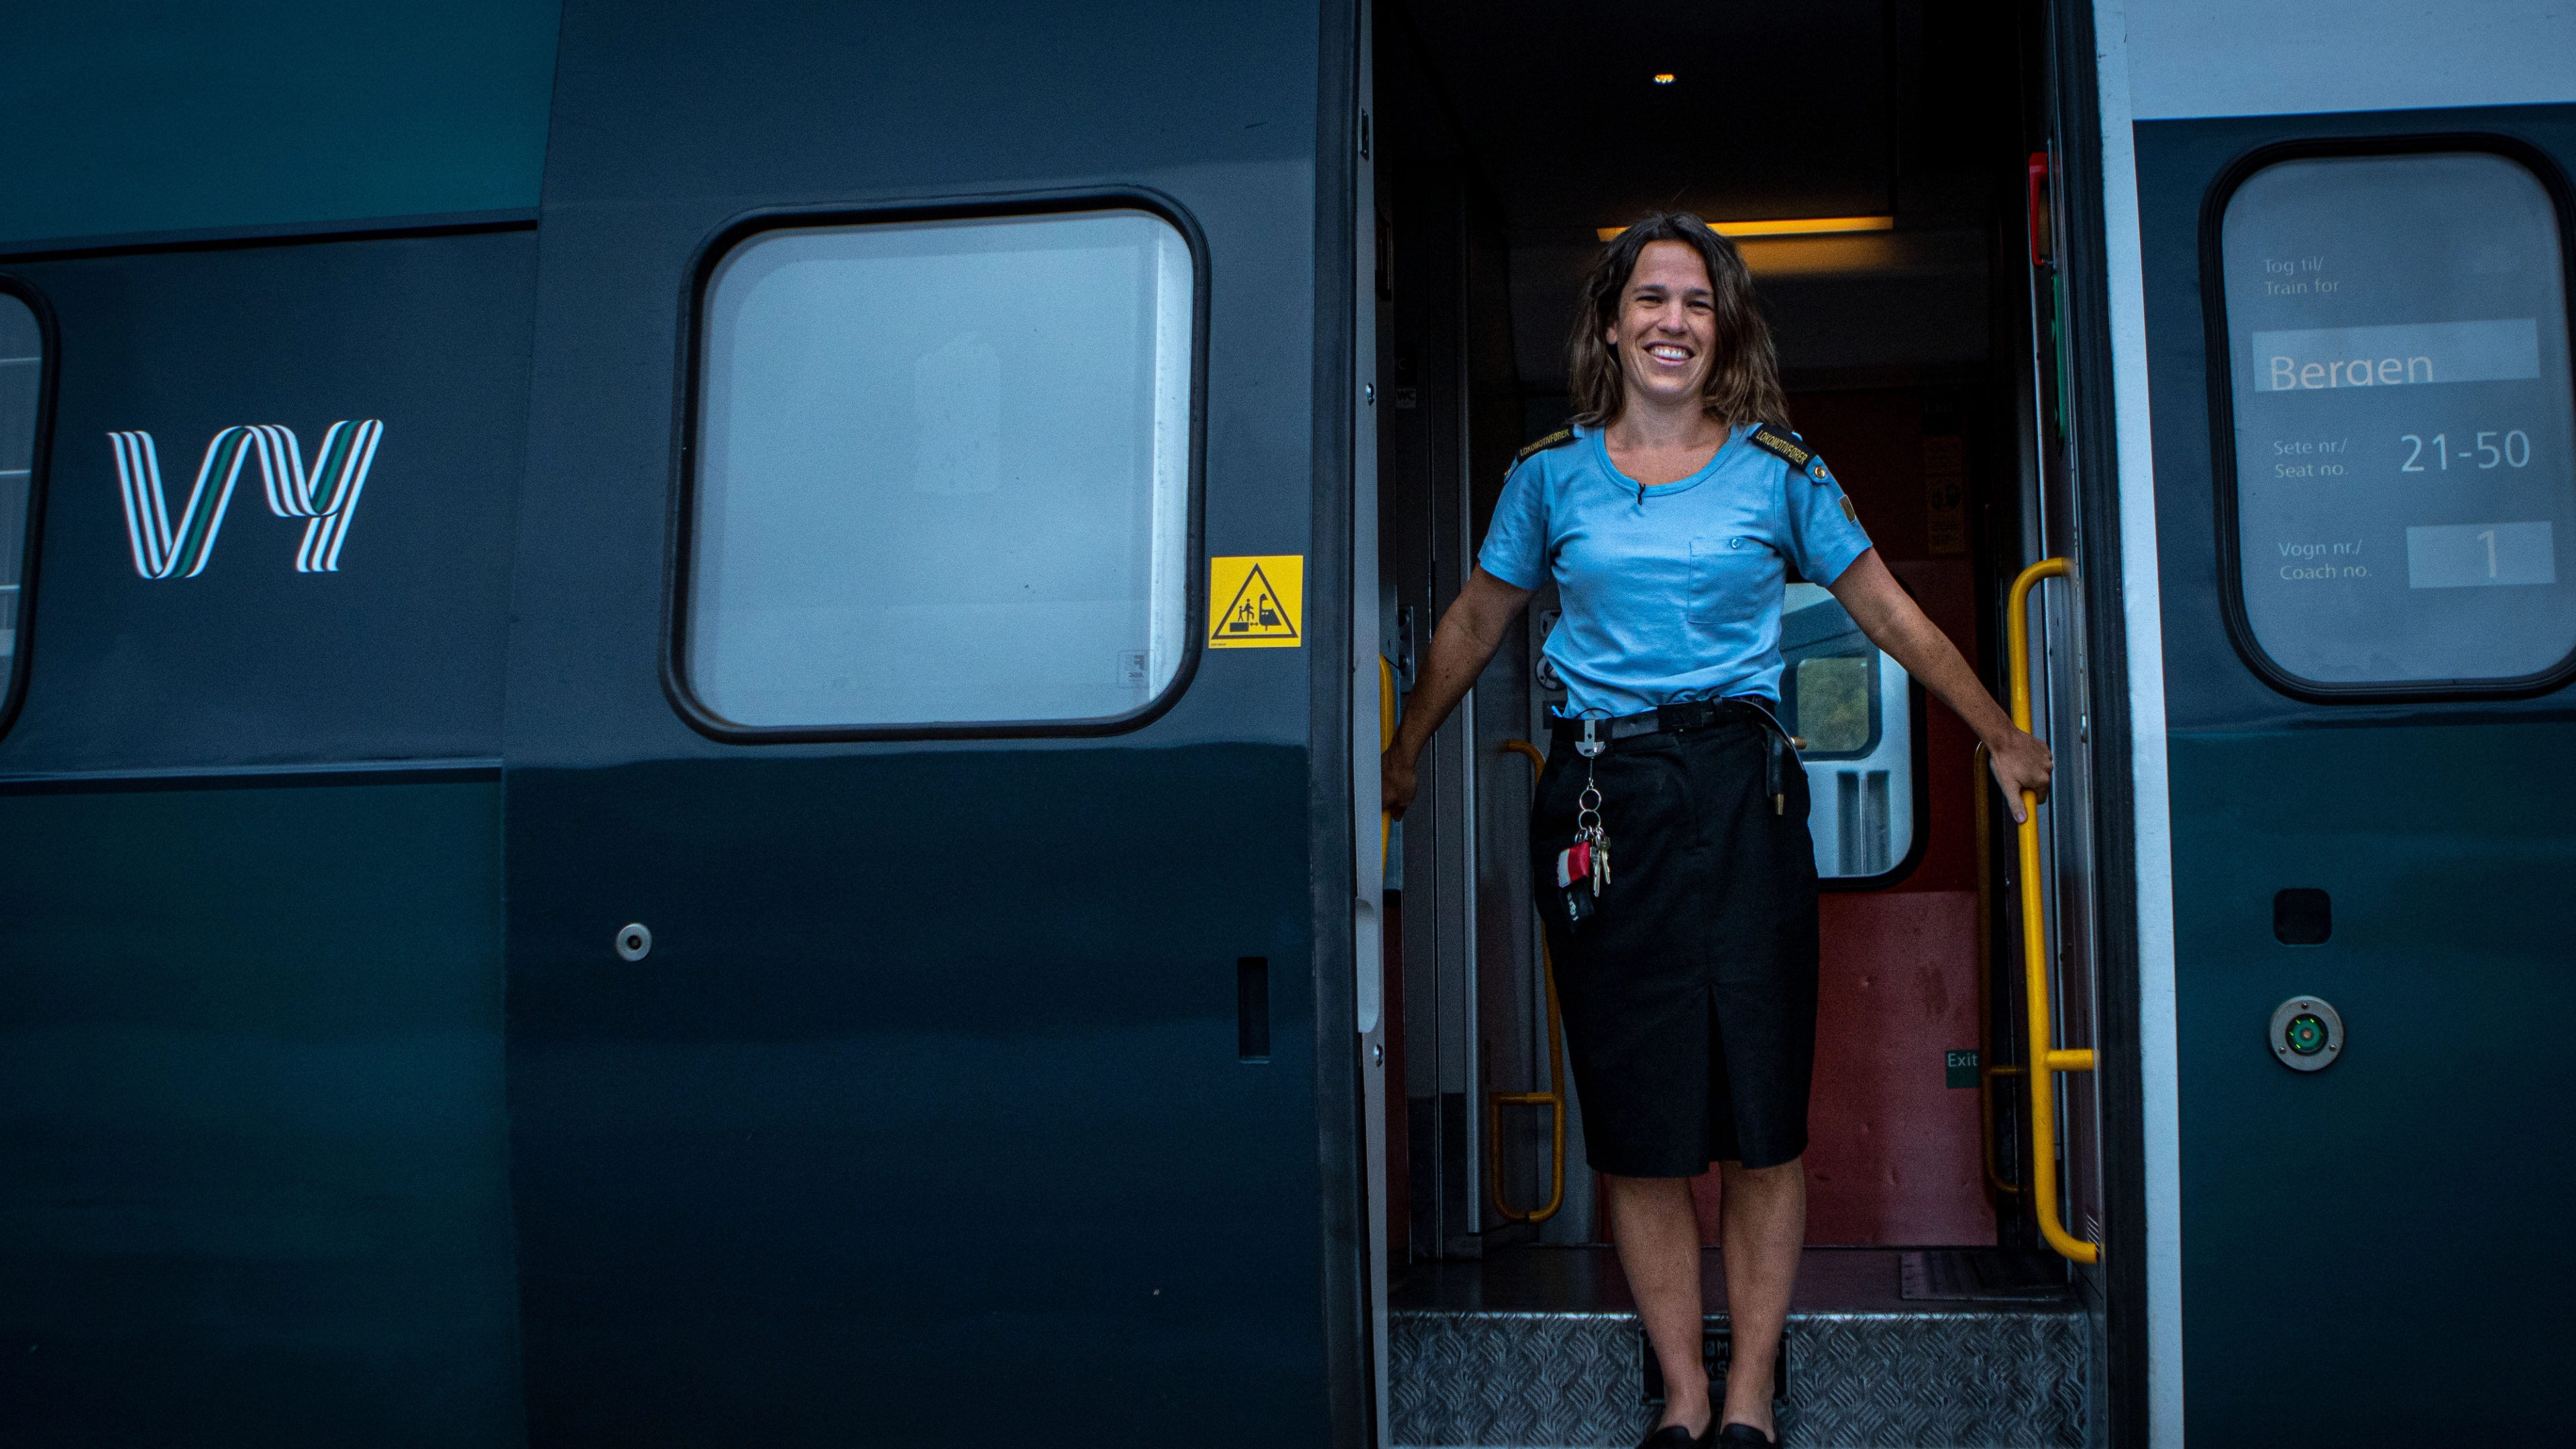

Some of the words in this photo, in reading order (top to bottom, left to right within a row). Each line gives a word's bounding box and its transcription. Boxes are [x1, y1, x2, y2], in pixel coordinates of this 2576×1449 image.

[2263, 259, 2294, 276] Tog
[2301, 256, 2324, 272] til/
[2265, 280, 2308, 295] Train
[2314, 277, 2341, 293] for
[1519, 429, 1570, 456] LOKOMOTIVFØRER
[1756, 429, 1809, 466] LOKOMOTIVFØRER
[2273, 440, 2313, 455] Sete
[2319, 437, 2348, 454] nr./
[2400, 429, 2531, 472] 21-50
[2275, 464, 2314, 478] Seat
[2320, 464, 2349, 477] no.
[2278, 541, 2326, 560] Vogn
[2333, 539, 2363, 555] nr./
[2477, 529, 2498, 578] 1
[2280, 563, 2337, 580] Coach
[2343, 565, 2372, 578] no.
[1947, 1053, 1978, 1068] Exit
